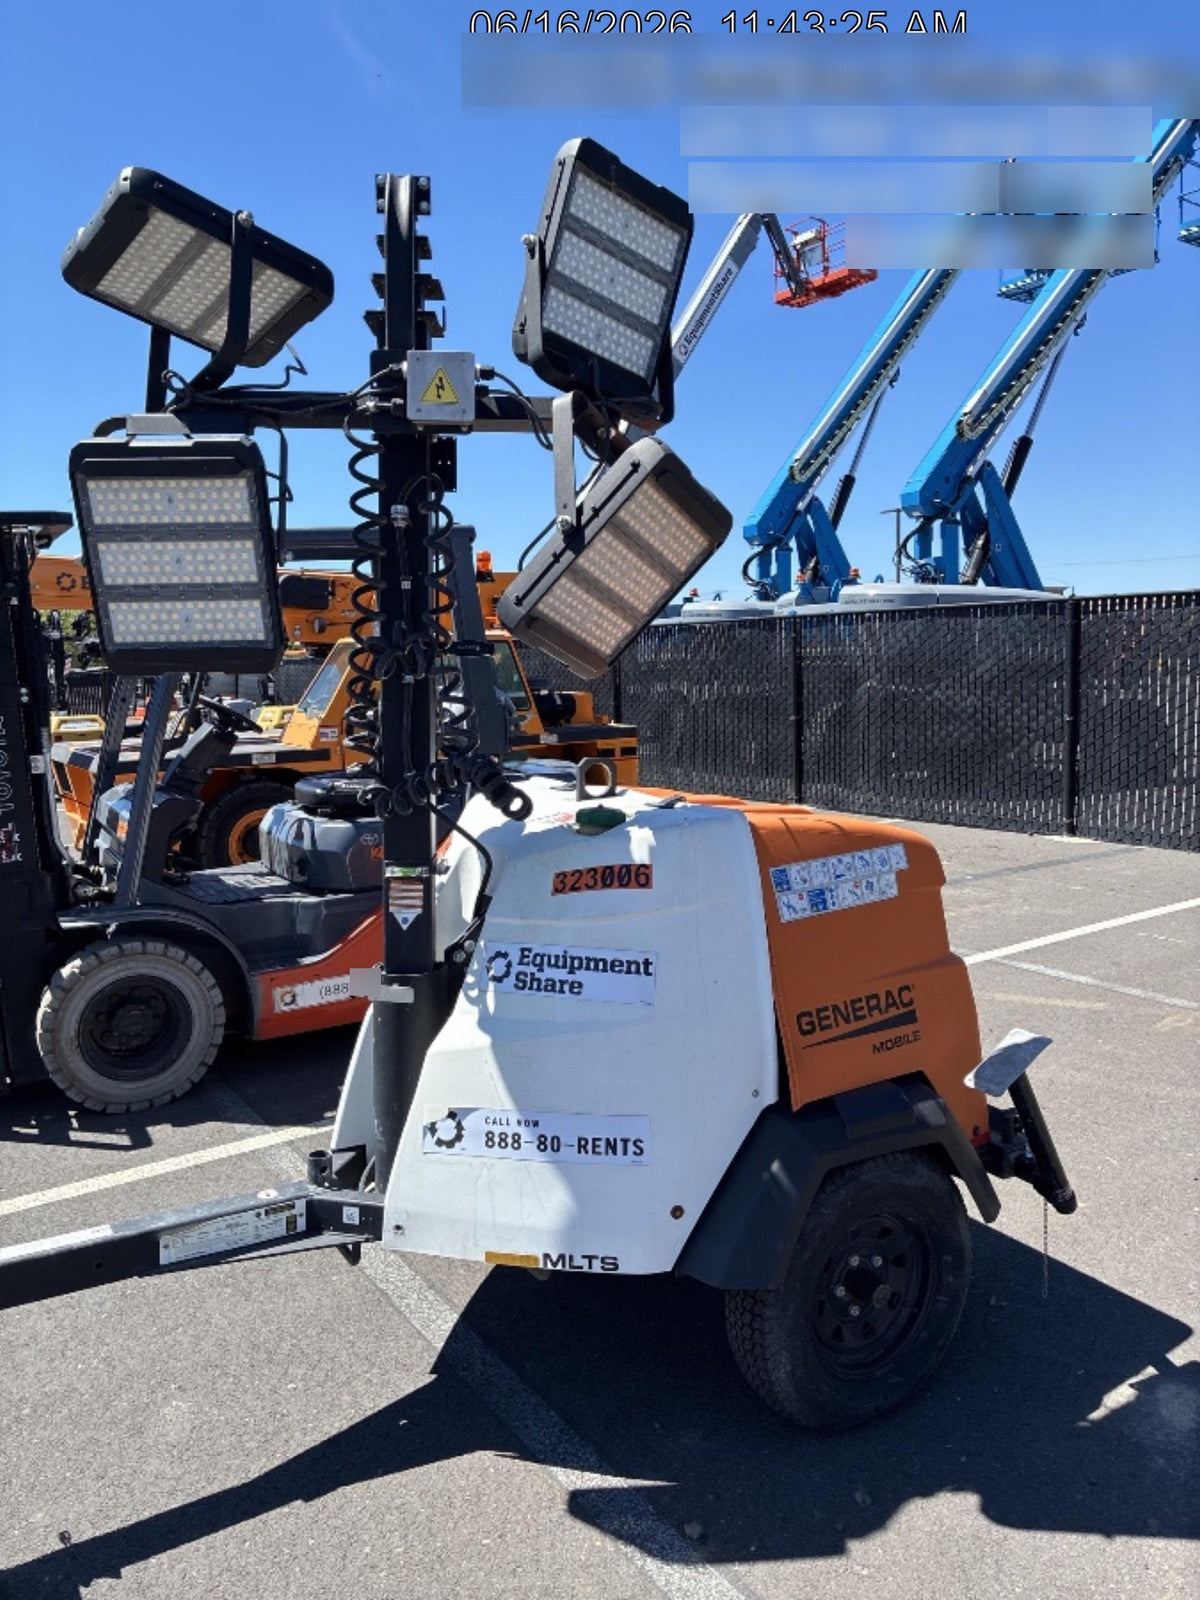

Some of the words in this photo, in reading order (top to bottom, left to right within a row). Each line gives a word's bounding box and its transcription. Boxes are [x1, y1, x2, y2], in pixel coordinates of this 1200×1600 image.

[0, 715, 15, 816] TOY
[554, 865, 651, 894] 323006
[516, 947, 654, 976] Equipment
[513, 970, 584, 996] Share
[796, 984, 914, 1037] GENERAC
[871, 1030, 922, 1055] MOBILE
[484, 1116, 511, 1127] CALL
[516, 1117, 540, 1128] NOW
[484, 1130, 645, 1157] 888-80-RENTS
[542, 1252, 620, 1272] MLTS
